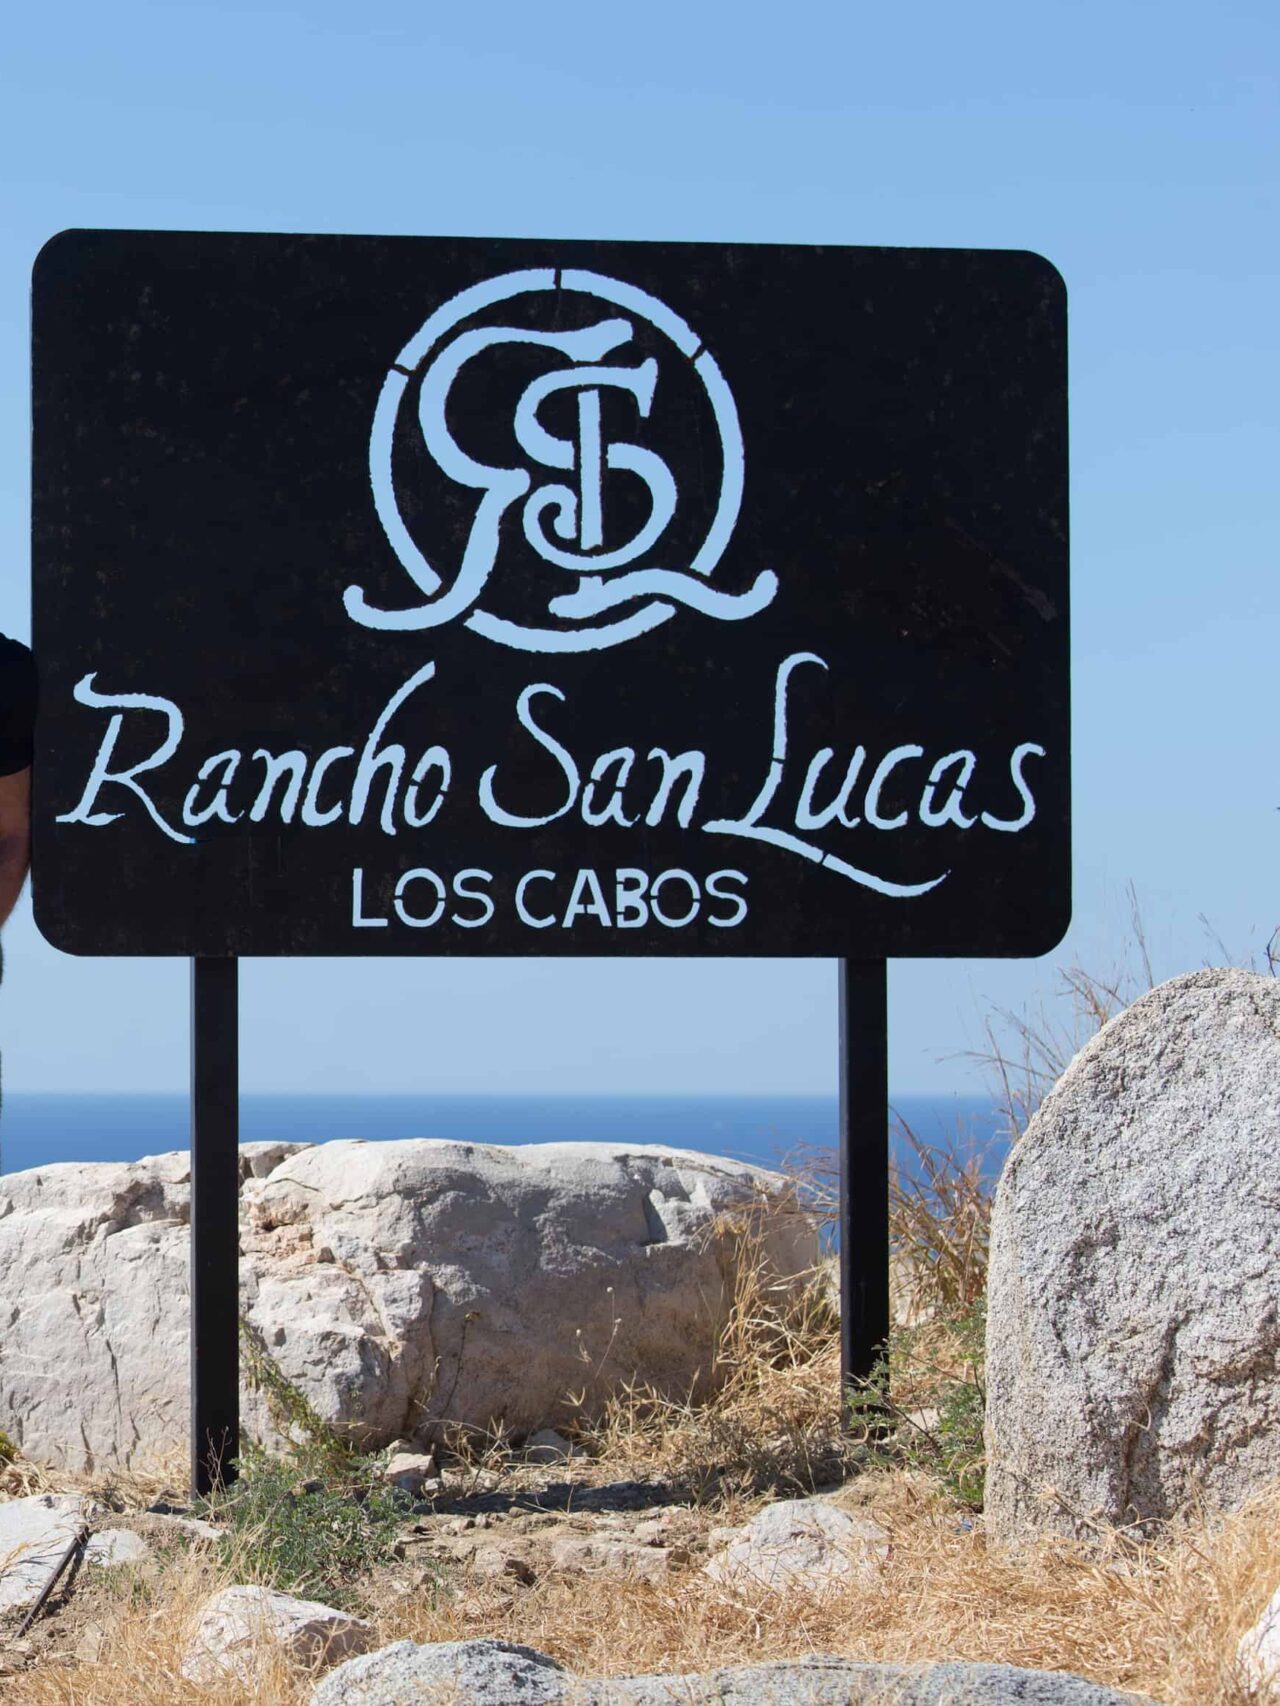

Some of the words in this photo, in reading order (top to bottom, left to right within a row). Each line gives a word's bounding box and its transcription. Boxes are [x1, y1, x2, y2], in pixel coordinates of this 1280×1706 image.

[56, 661, 452, 843] Rancho
[479, 683, 706, 828] San
[702, 652, 1046, 898] Lucas
[353, 867, 495, 929] LOS
[515, 867, 749, 929] CABOS
